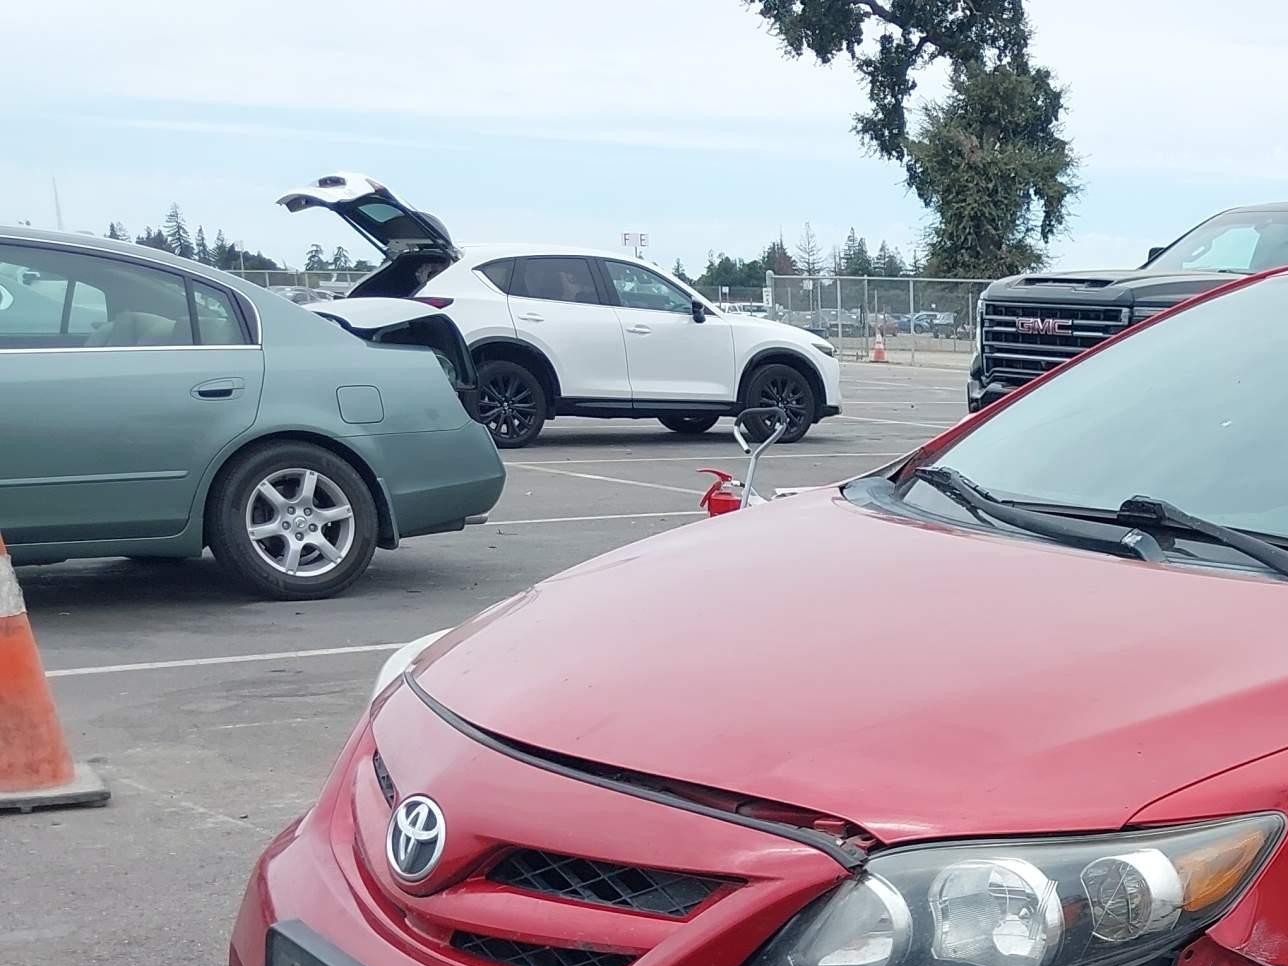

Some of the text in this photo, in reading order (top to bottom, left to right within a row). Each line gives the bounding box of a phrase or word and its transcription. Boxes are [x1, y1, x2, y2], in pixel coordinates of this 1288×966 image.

[623, 233, 630, 246] F
[640, 233, 648, 246] E
[1015, 317, 1072, 336] GMC
